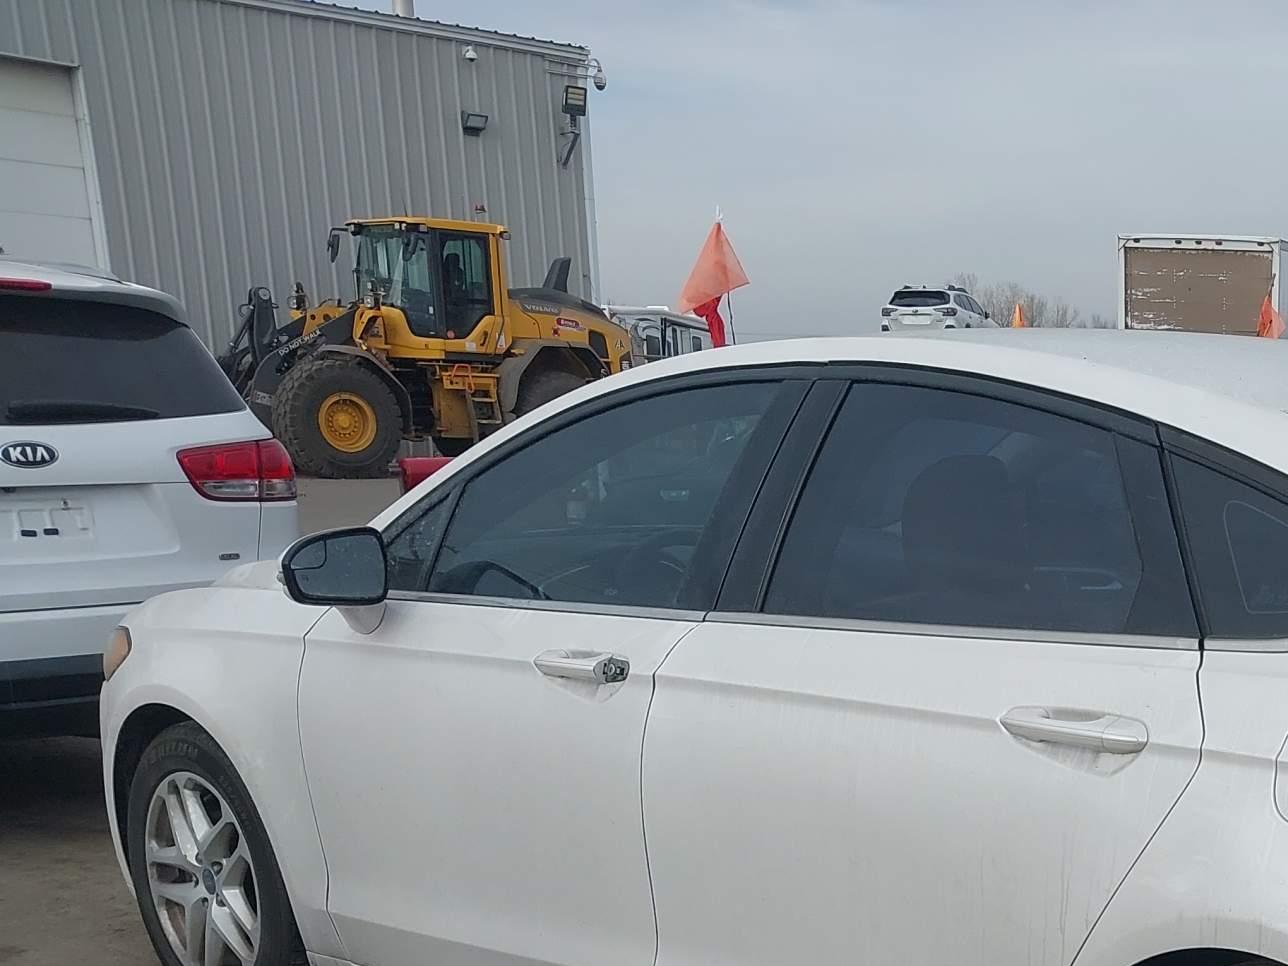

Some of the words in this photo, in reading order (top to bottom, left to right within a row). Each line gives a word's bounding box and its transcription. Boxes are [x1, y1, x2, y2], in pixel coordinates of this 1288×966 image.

[279, 346, 290, 356] DO
[288, 336, 304, 351] NOT
[303, 328, 321, 343] WALK
[8, 446, 51, 462] KIA
